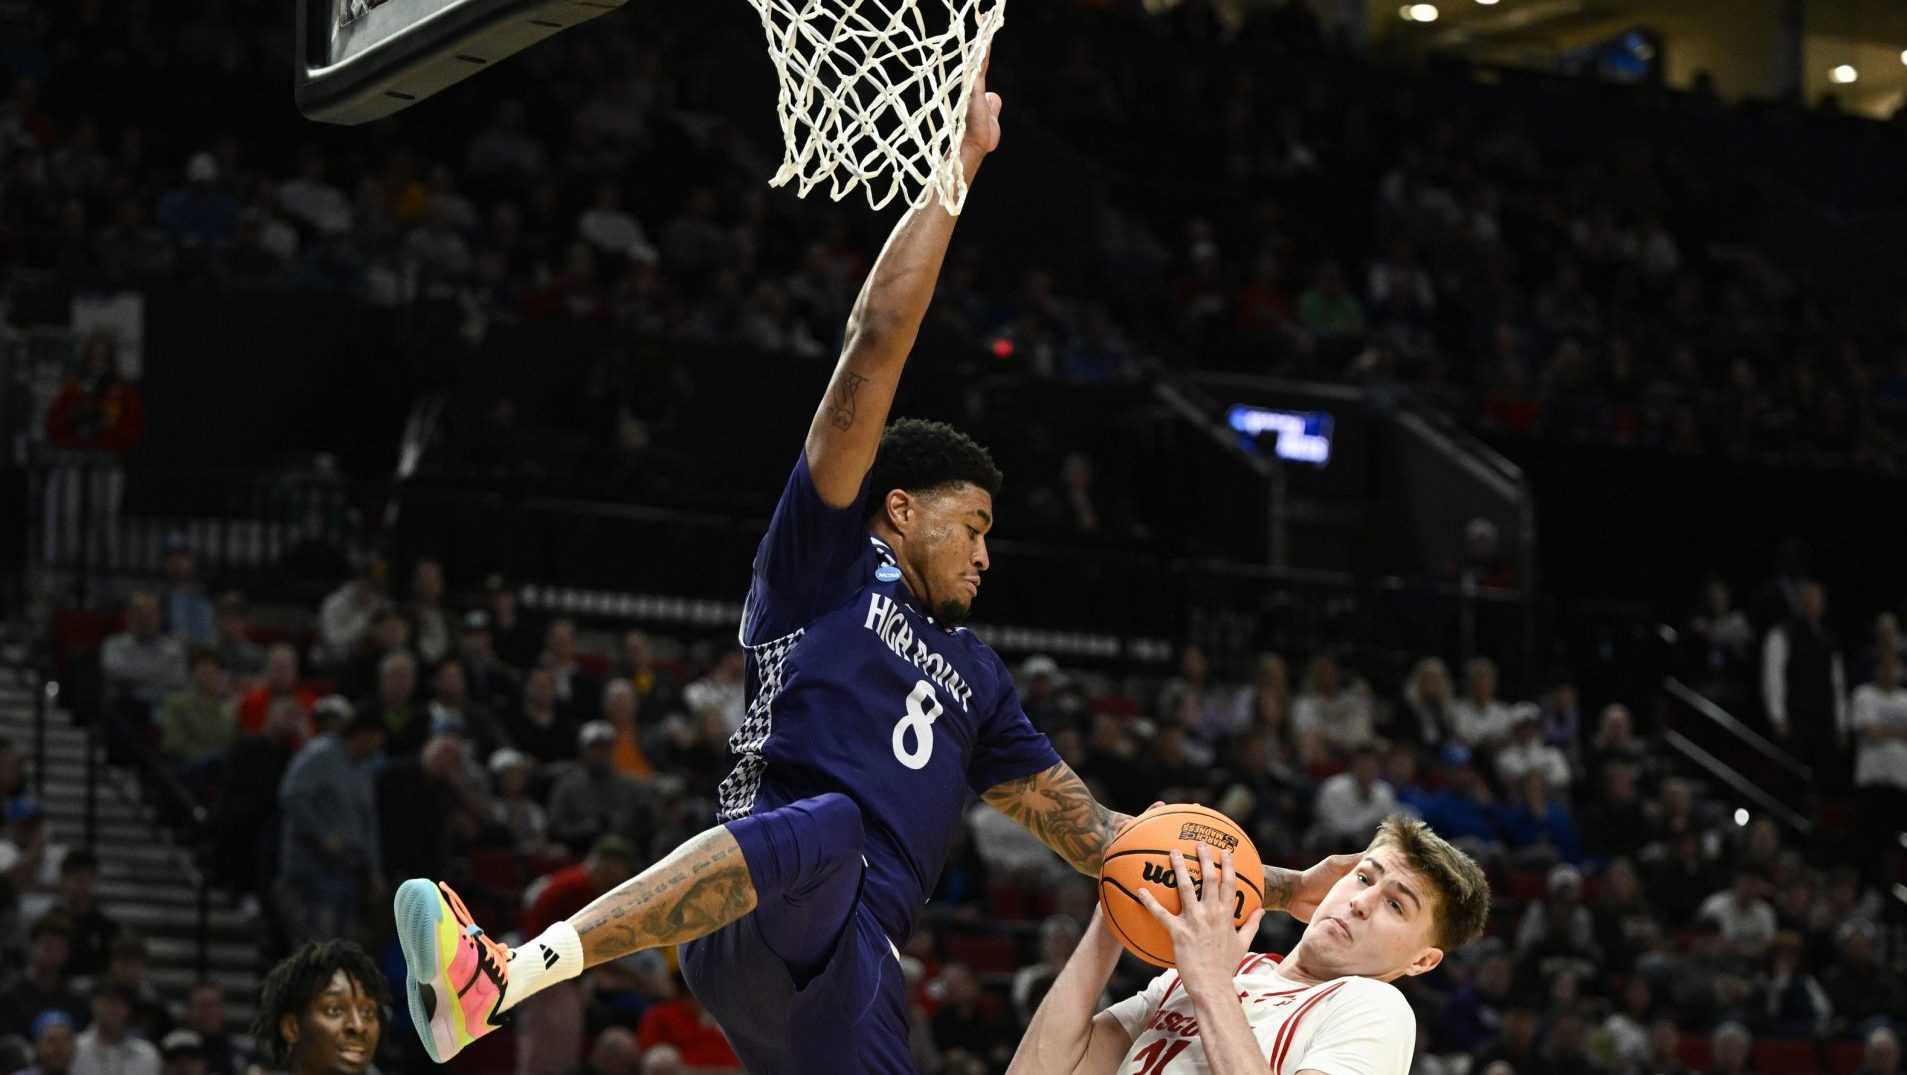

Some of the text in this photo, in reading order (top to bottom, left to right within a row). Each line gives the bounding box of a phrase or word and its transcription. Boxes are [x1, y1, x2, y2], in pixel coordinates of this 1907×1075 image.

[864, 593, 913, 661] HIGH
[914, 639, 973, 712] POINT
[892, 680, 943, 769] 8
[1182, 822, 1225, 841] MADNESS
[1195, 832, 1227, 849] MARCH
